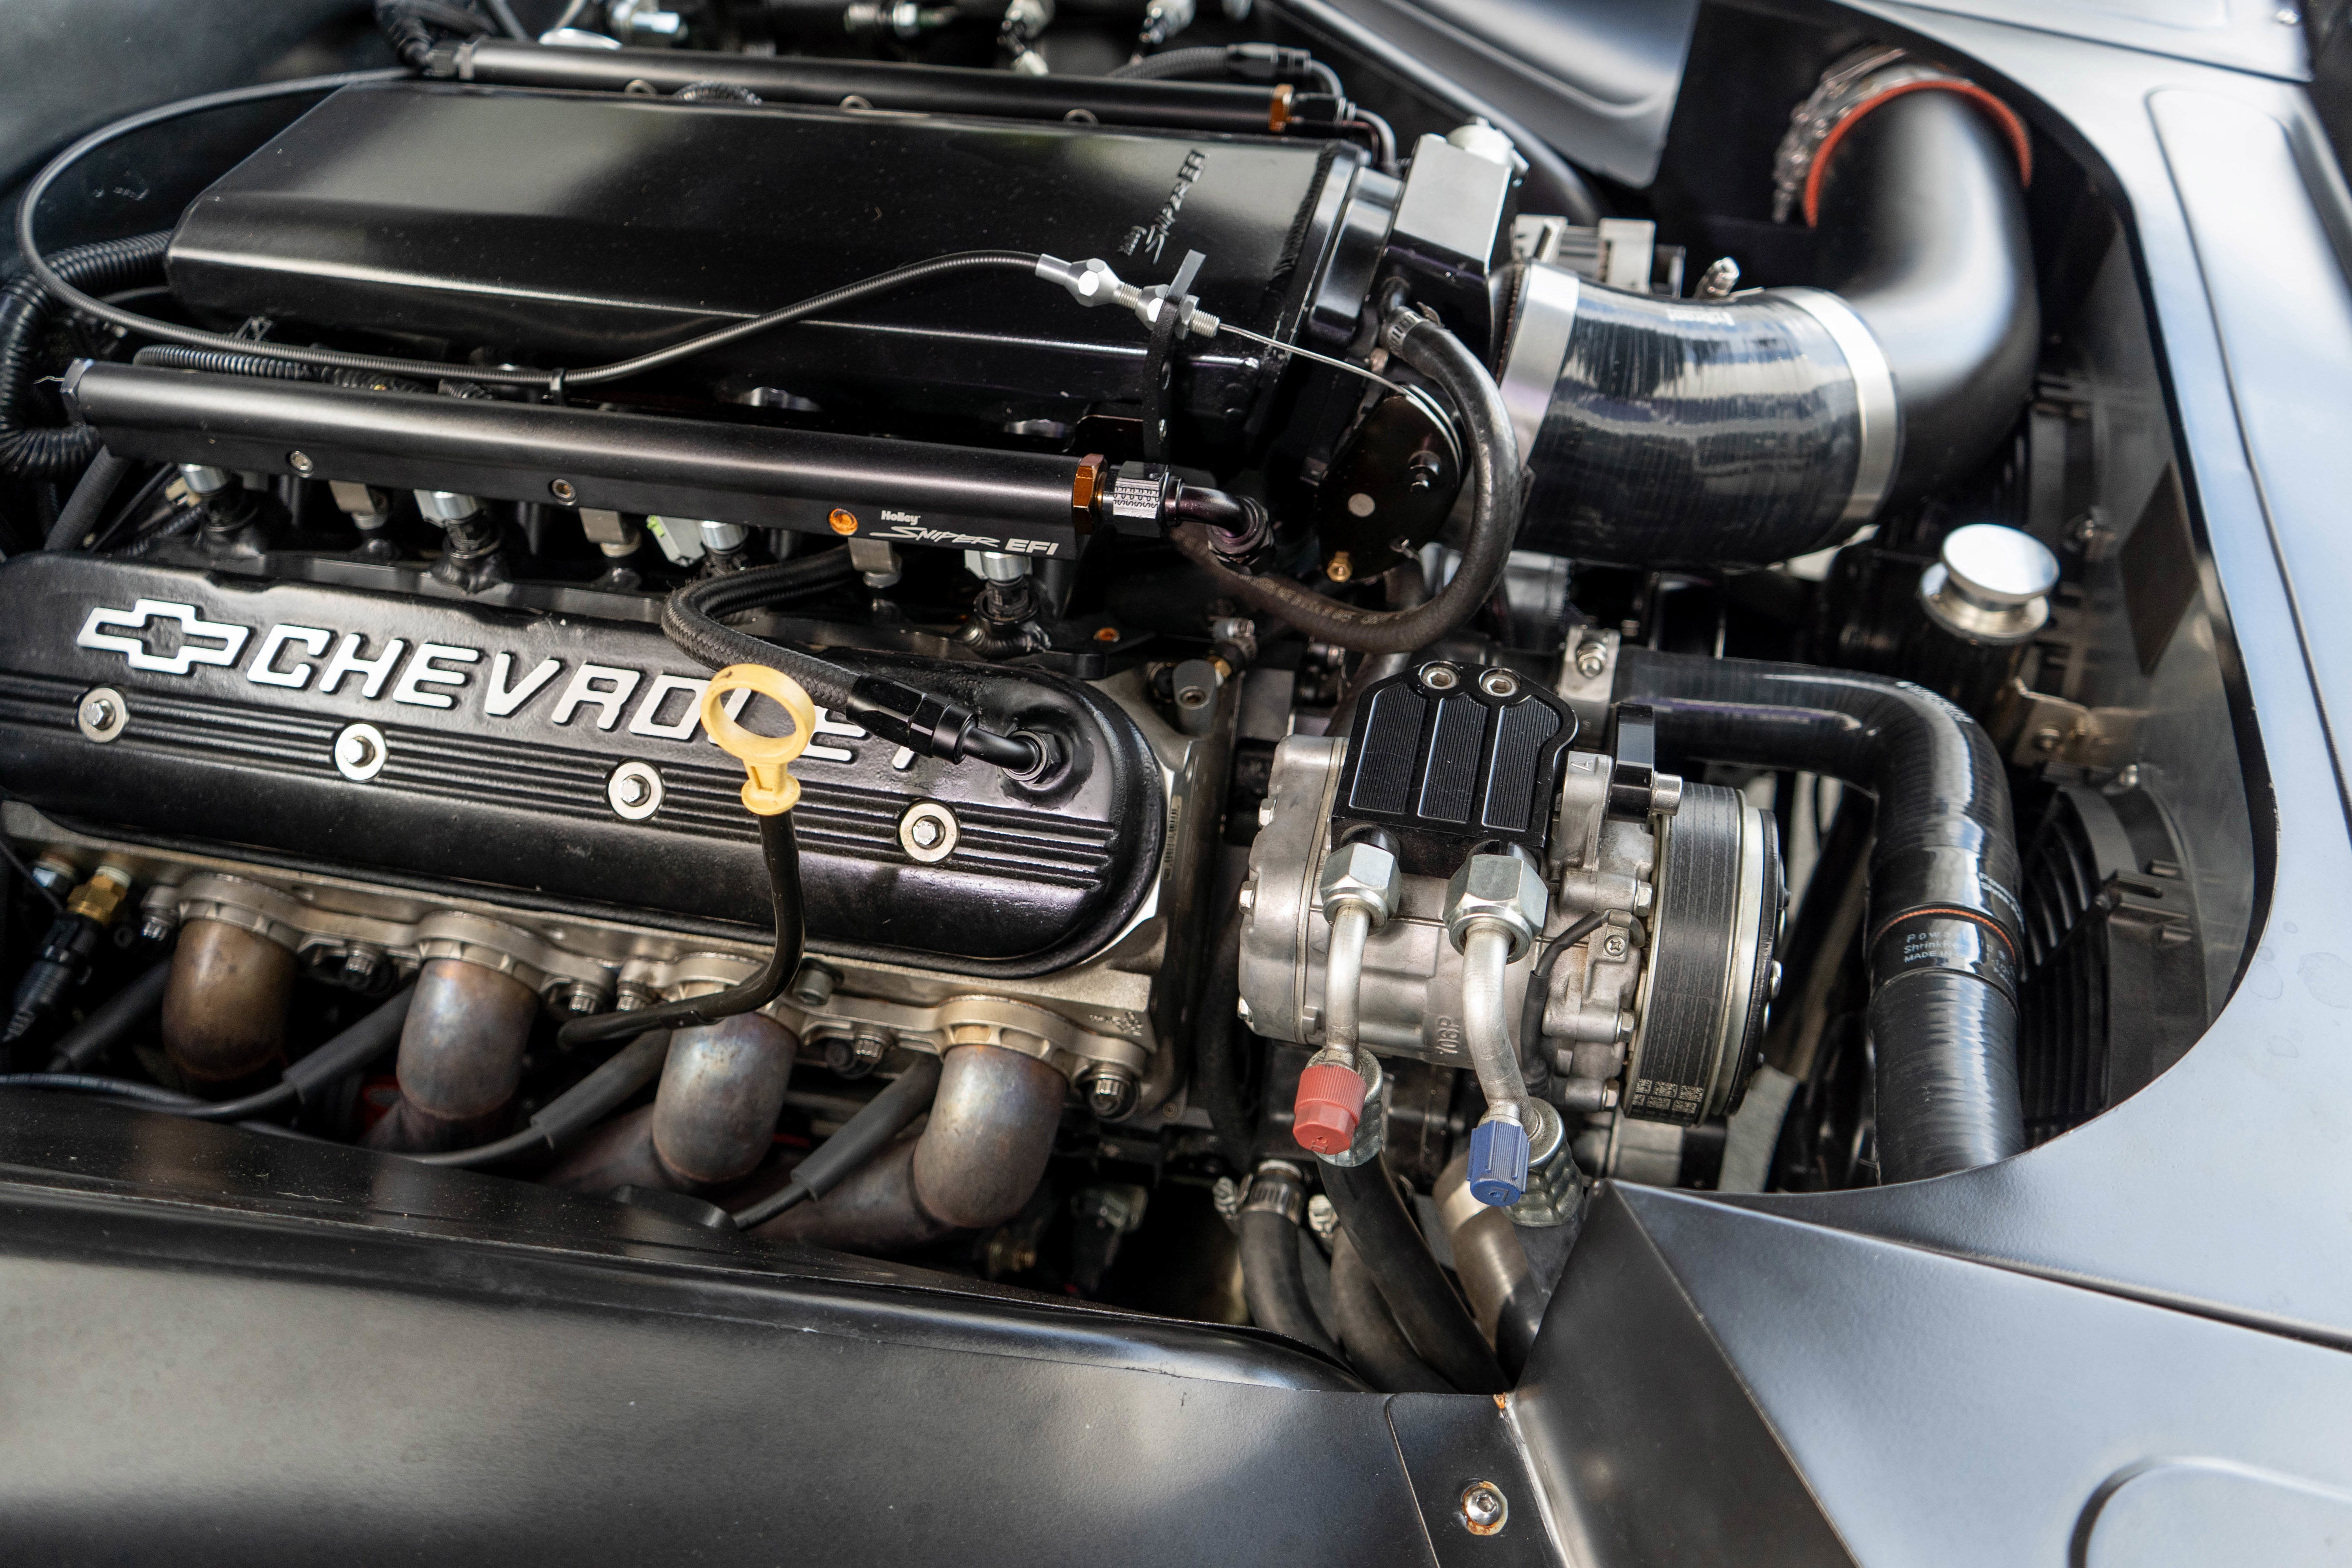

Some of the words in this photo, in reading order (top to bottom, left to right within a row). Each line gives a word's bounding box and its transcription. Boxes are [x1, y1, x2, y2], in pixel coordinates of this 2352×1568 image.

[881, 510, 919, 526] Holley
[869, 526, 1000, 548] SNIPER
[1005, 538, 1059, 555] EFI
[246, 624, 915, 769] CHEVROE
[1904, 950, 1937, 963] MADE
